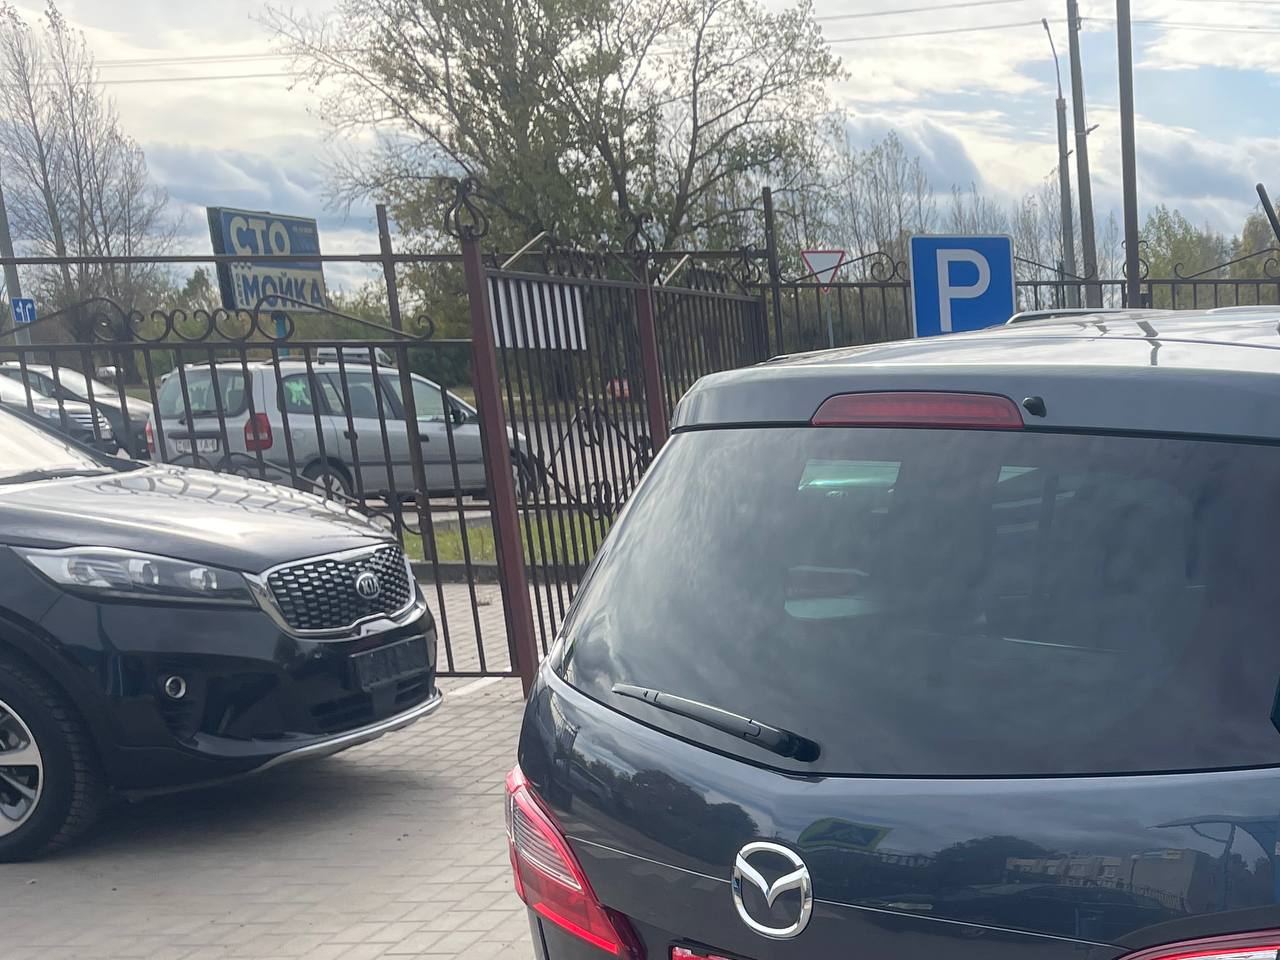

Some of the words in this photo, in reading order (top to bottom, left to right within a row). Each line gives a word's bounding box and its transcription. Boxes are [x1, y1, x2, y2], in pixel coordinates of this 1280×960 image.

[230, 216, 291, 258] СТО
[241, 271, 328, 308] МОЙКА
[936, 249, 990, 332] P
